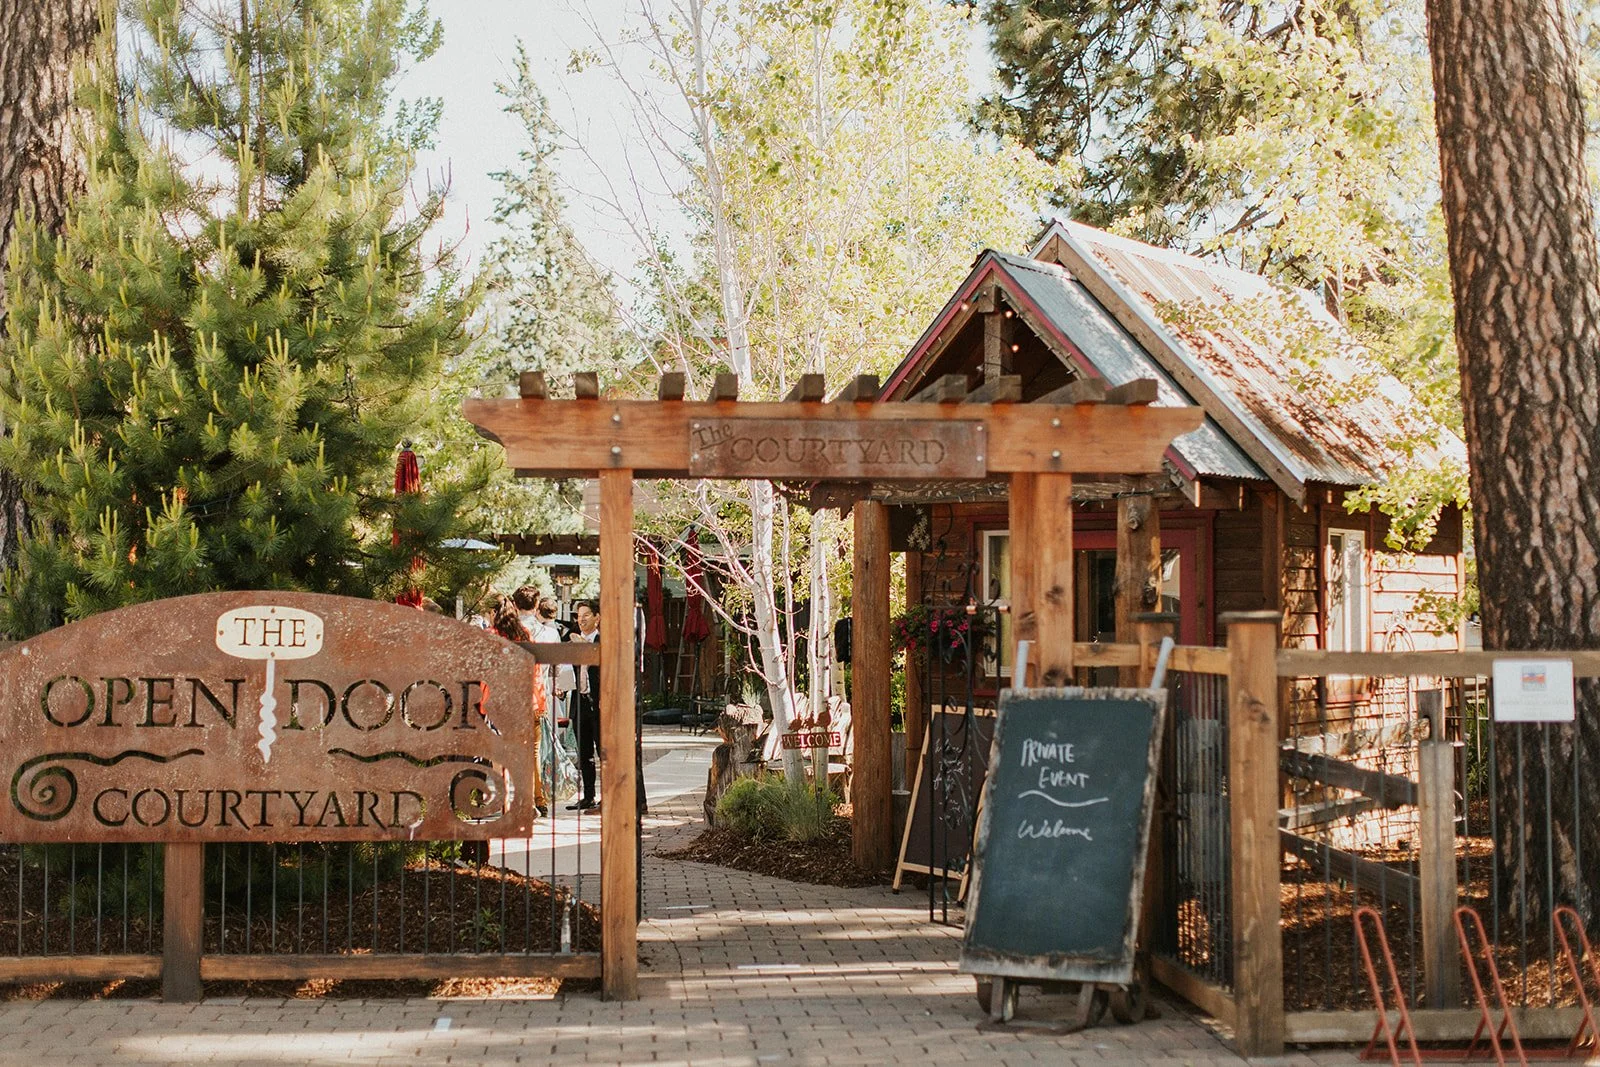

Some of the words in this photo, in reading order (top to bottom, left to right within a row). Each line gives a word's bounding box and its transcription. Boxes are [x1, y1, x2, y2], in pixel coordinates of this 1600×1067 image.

[692, 423, 732, 449] The
[730, 437, 945, 466] COURTYARD
[234, 618, 307, 648] THE
[40, 675, 245, 727] OPEN
[283, 679, 501, 736] DOOR
[783, 732, 840, 748] WELCOME
[1038, 766, 1089, 789] EVENT
[93, 788, 427, 831] COURTYARD
